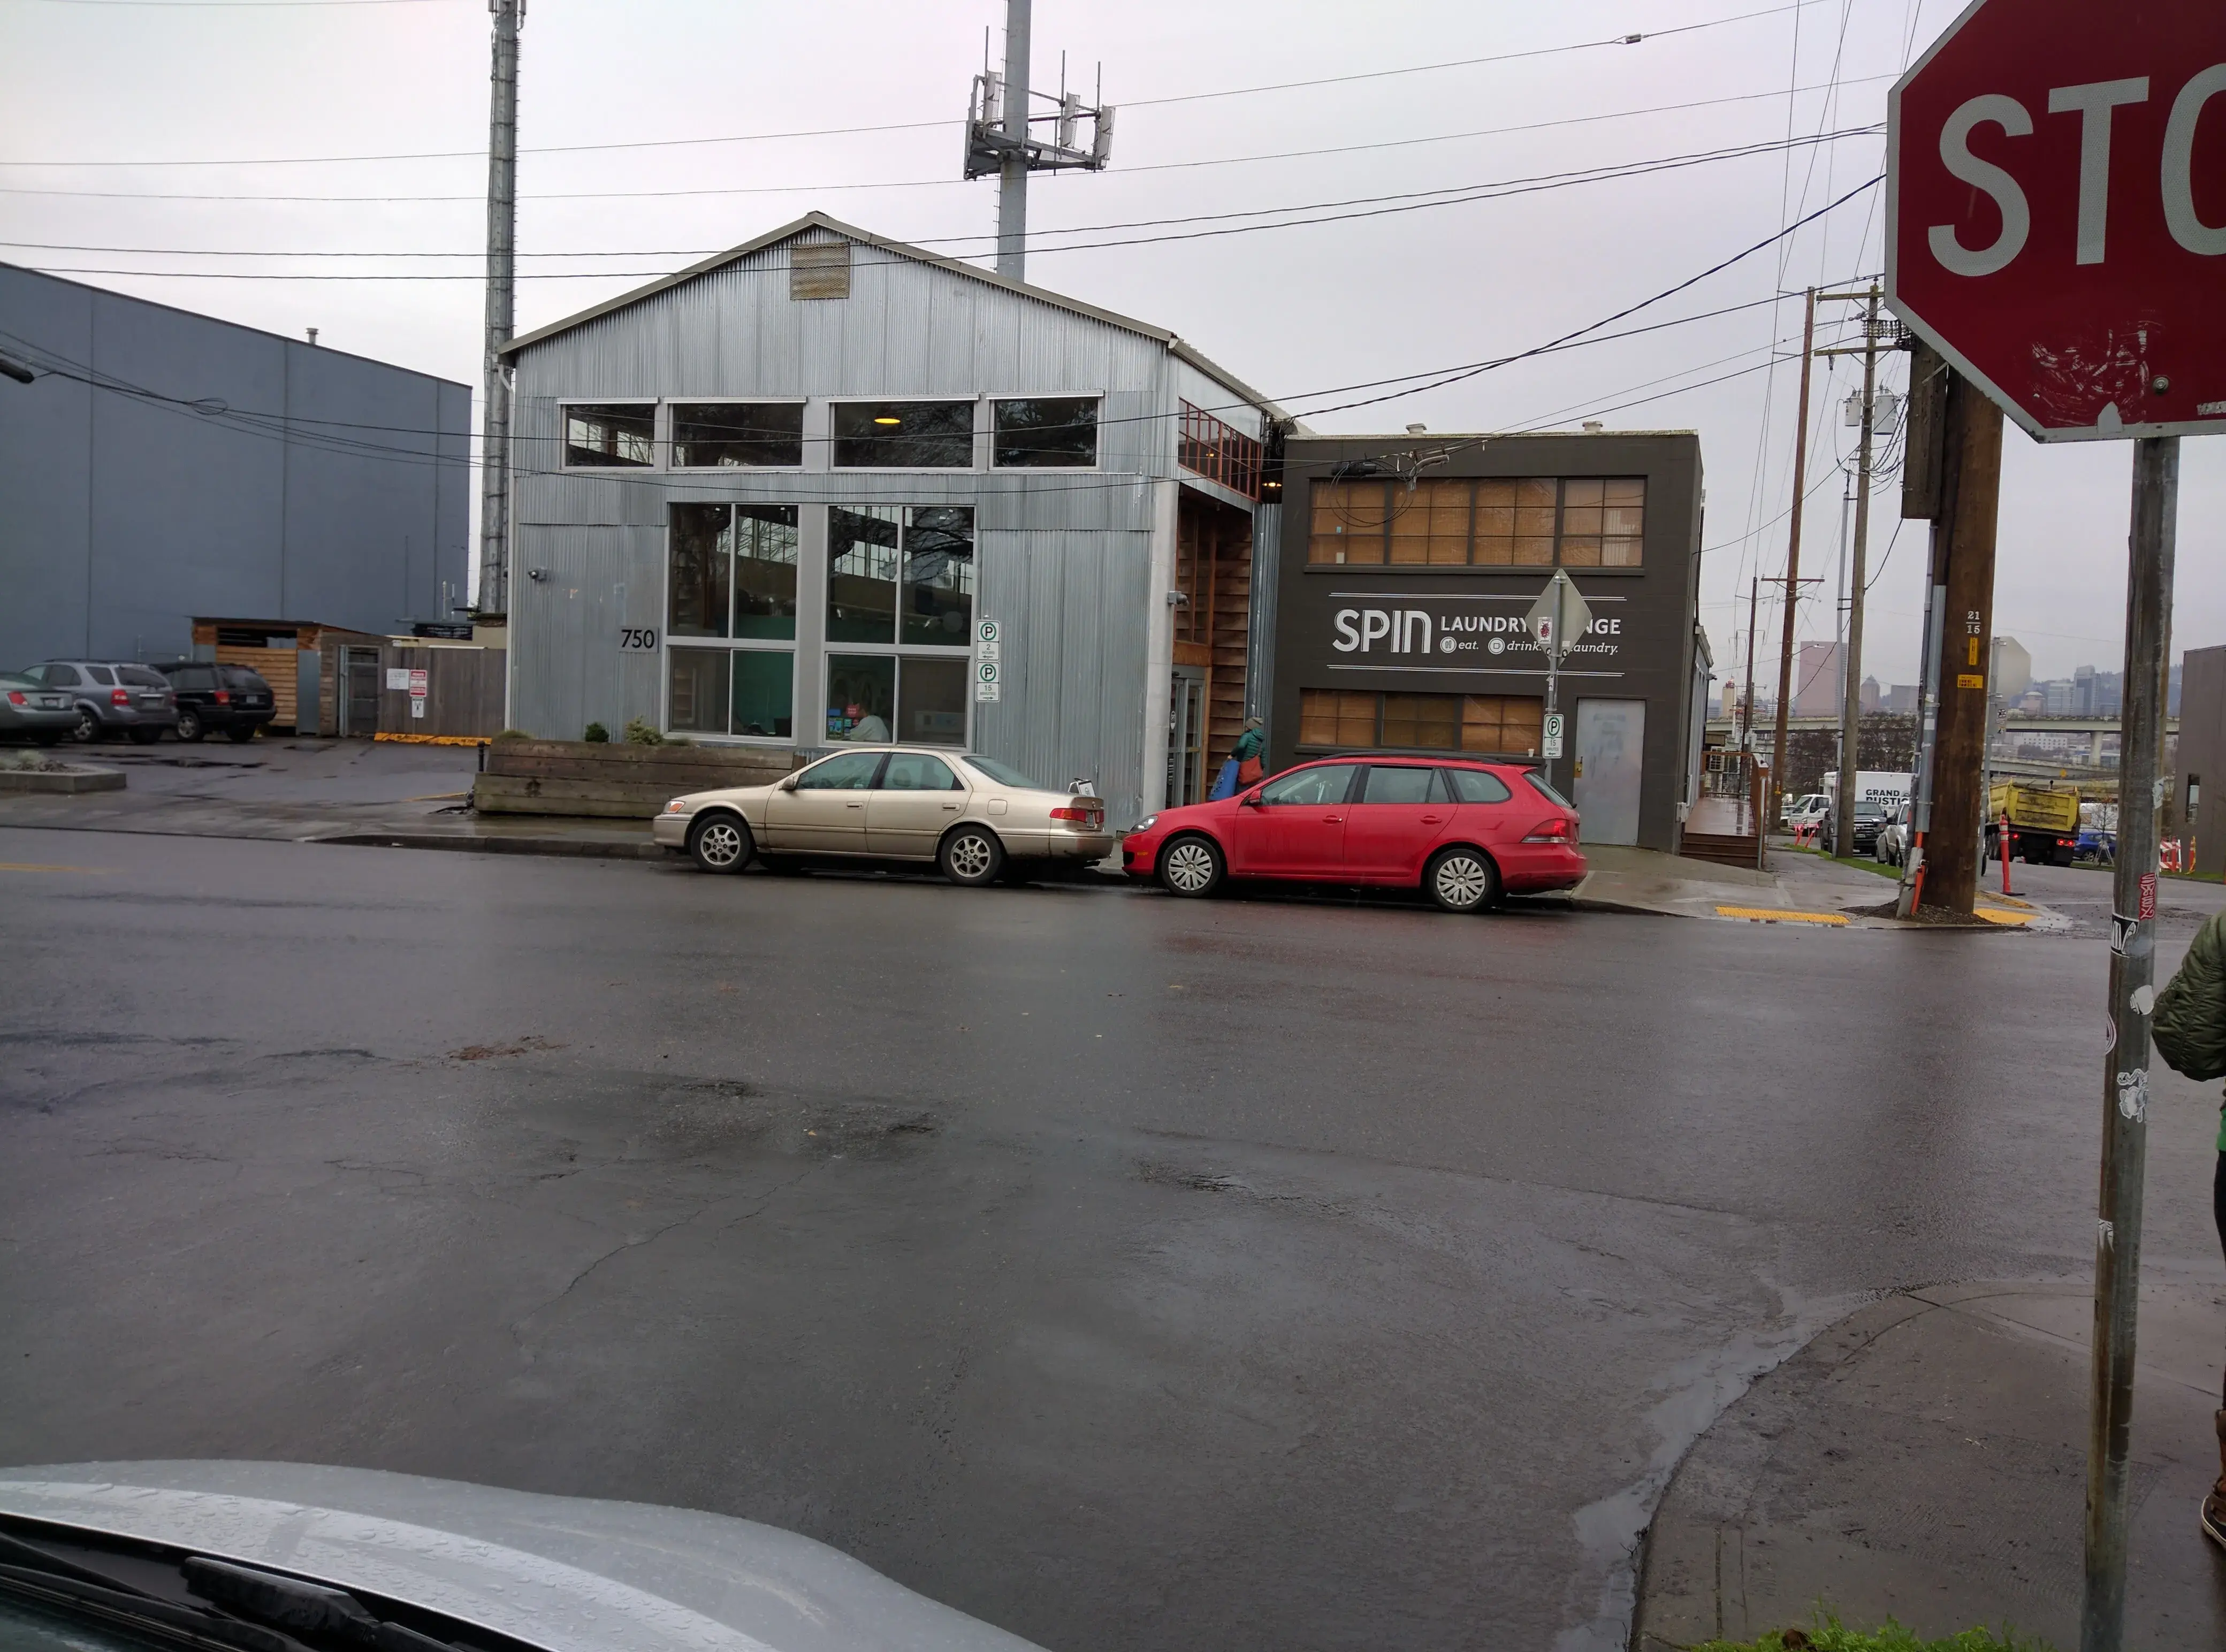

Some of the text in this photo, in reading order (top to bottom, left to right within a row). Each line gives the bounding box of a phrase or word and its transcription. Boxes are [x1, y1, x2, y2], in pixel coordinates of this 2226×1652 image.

[1968, 610, 1980, 620] 21
[985, 626, 993, 637] P
[1332, 609, 1432, 653] SPIN
[1440, 616, 1527, 633] LAUNDRY
[1966, 625, 1980, 634] 15
[621, 629, 654, 648] 750
[1458, 641, 1618, 655] eat. drink. aundry.
[985, 668, 993, 678] P
[1551, 721, 1558, 733] P
